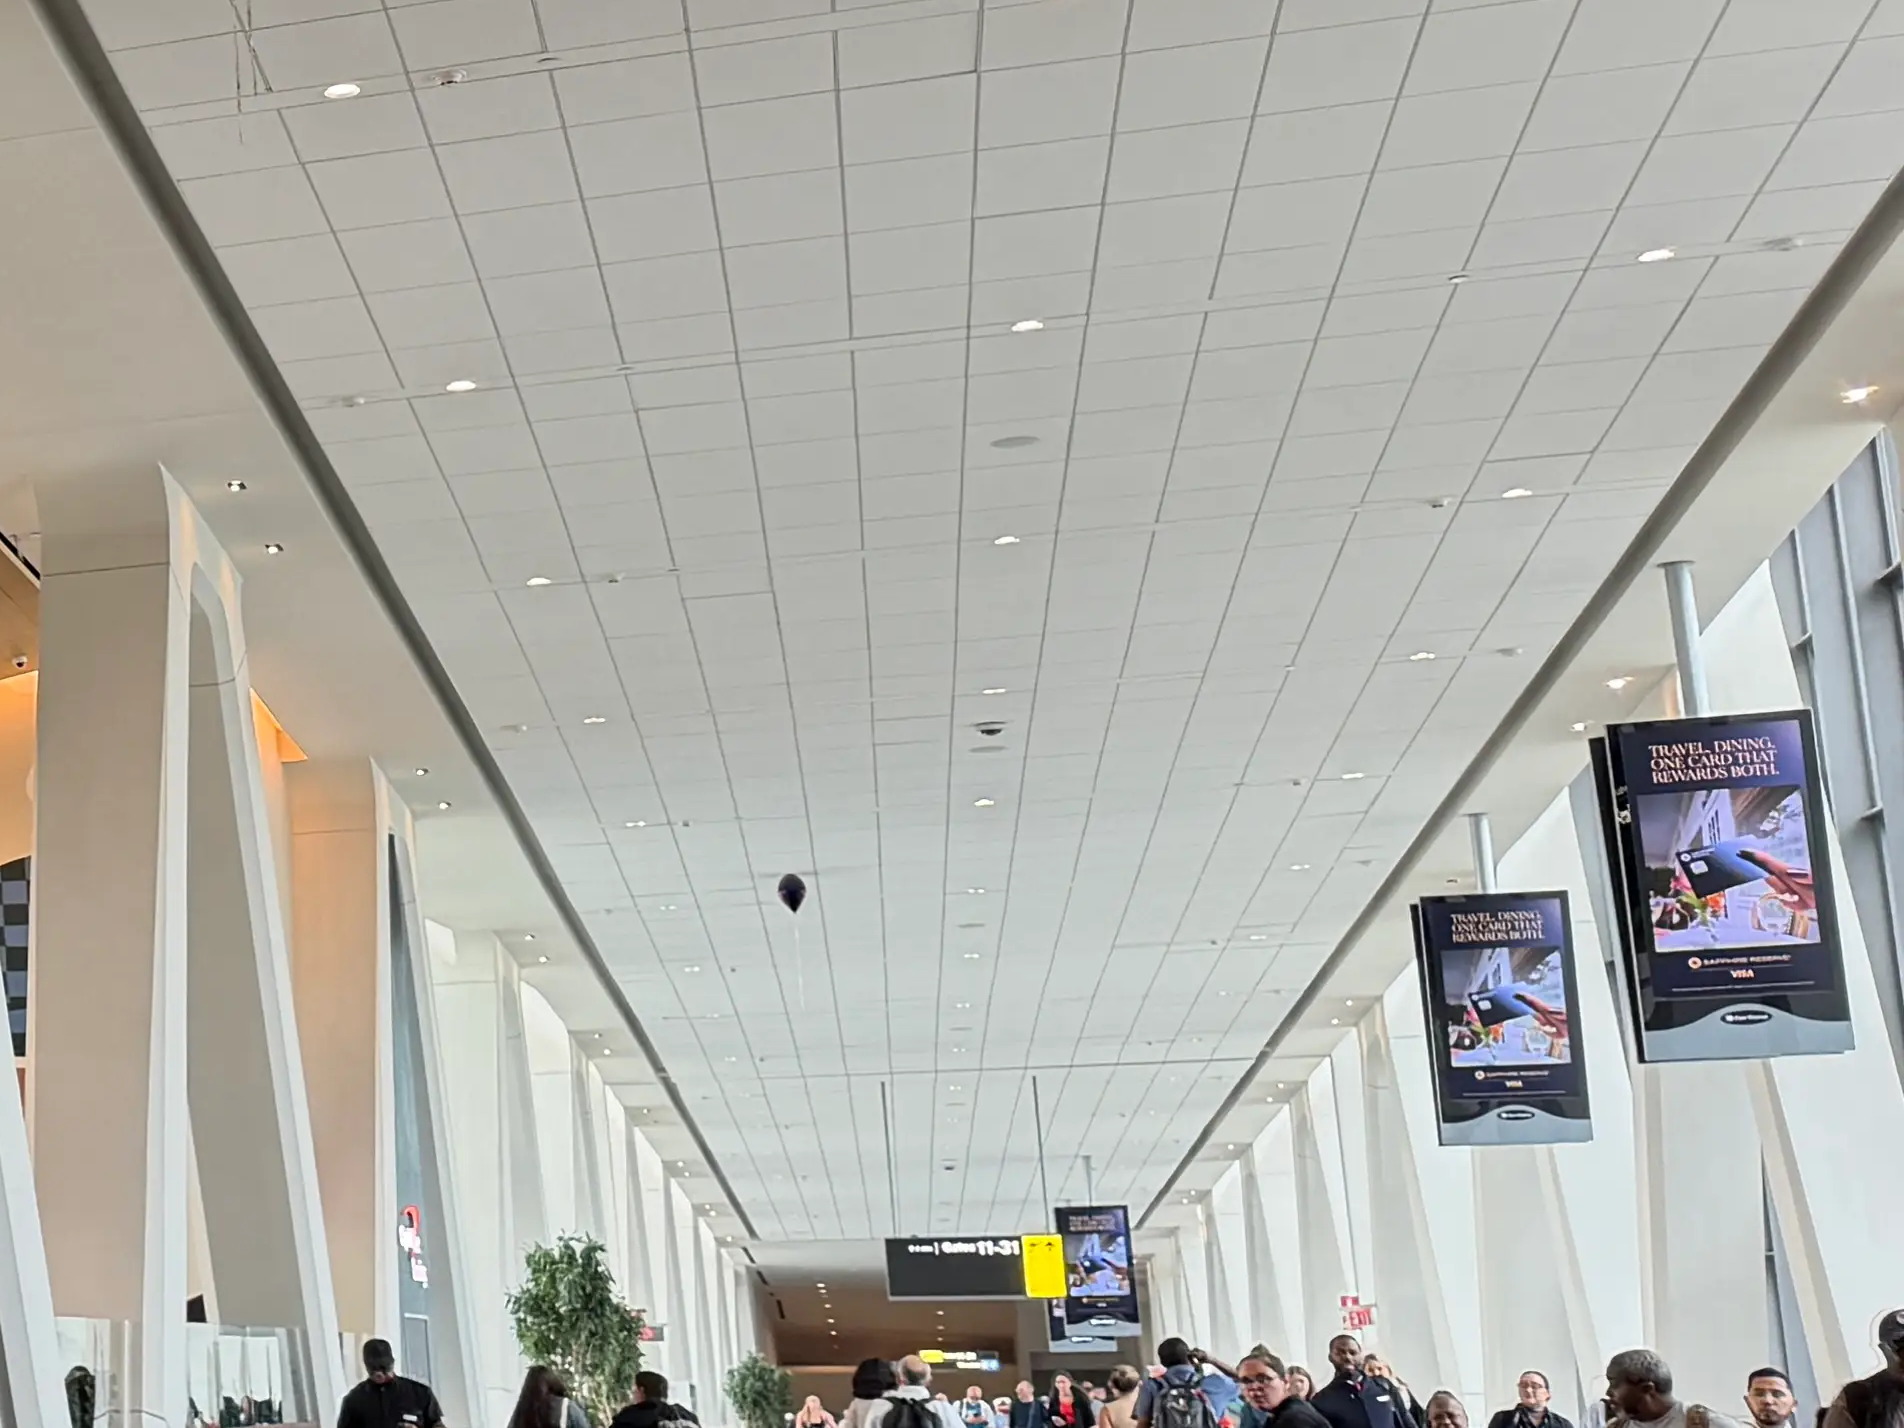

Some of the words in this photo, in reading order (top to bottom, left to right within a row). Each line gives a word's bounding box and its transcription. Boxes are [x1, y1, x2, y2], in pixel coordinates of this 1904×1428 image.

[1648, 741, 1711, 757] TRAVEL.
[1714, 736, 1775, 753] DINING.
[1650, 756, 1685, 771] ONE
[1688, 753, 1733, 768] CARD
[1735, 750, 1777, 764] THAT
[1652, 766, 1728, 784] REWARDS
[1731, 763, 1780, 778] BOTH.
[1451, 922, 1477, 933] ONE
[1478, 920, 1512, 931] CARD
